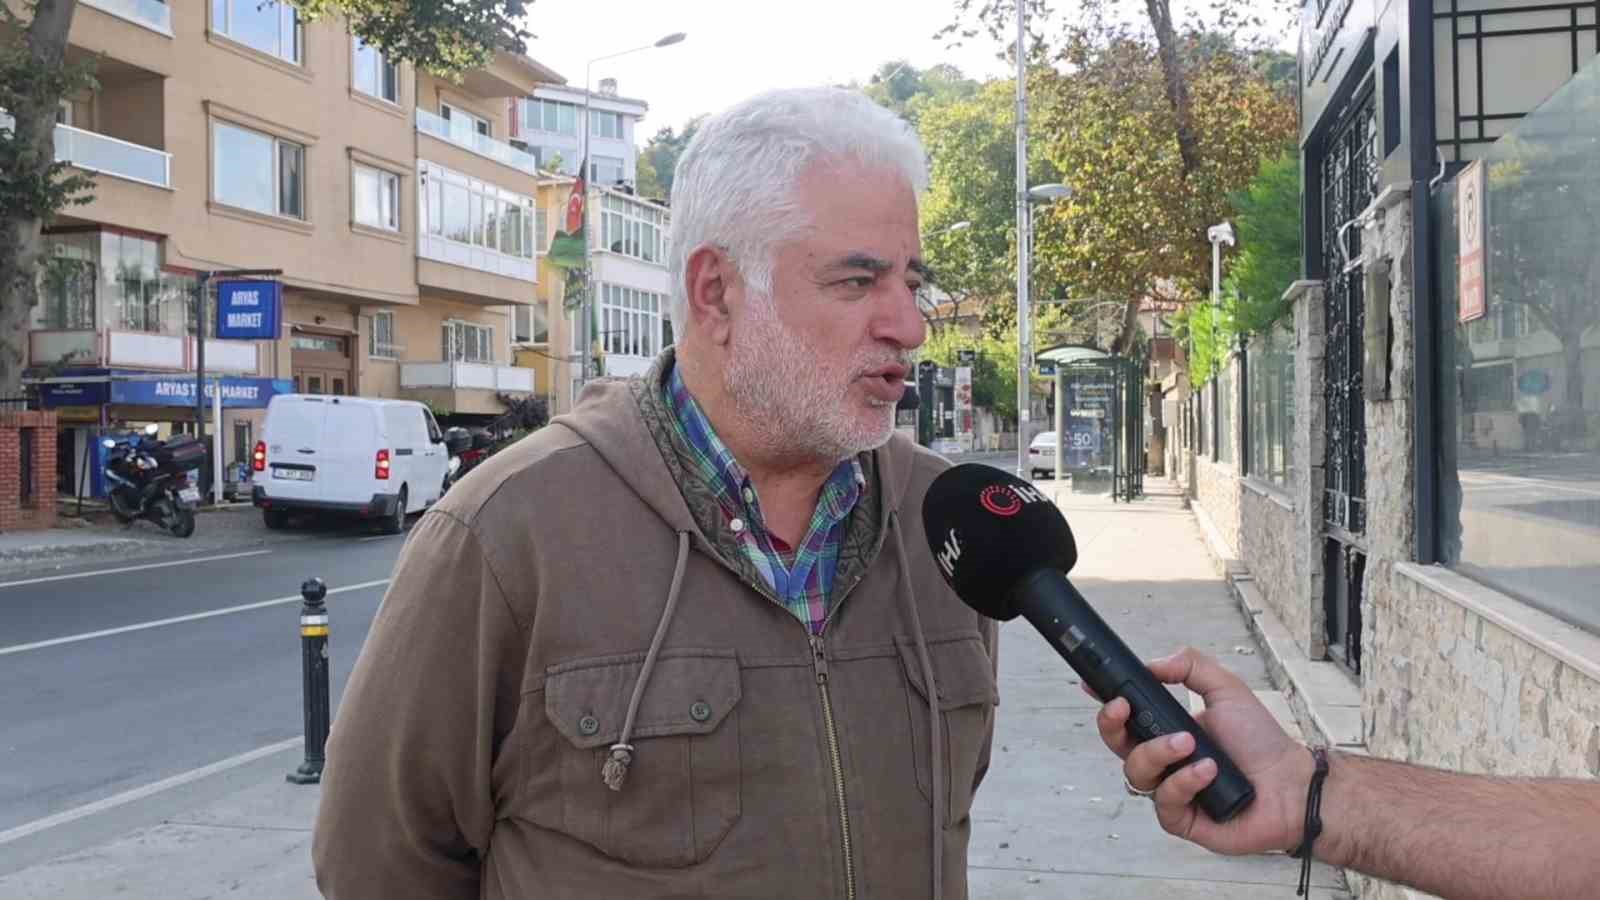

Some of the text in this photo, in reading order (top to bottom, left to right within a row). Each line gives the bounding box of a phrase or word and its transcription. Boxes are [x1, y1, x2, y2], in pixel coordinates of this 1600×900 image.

[231, 290, 259, 306] ARYAS
[227, 312, 262, 328] MARKET
[155, 382, 258, 399] ARYAS TKE MARKET
